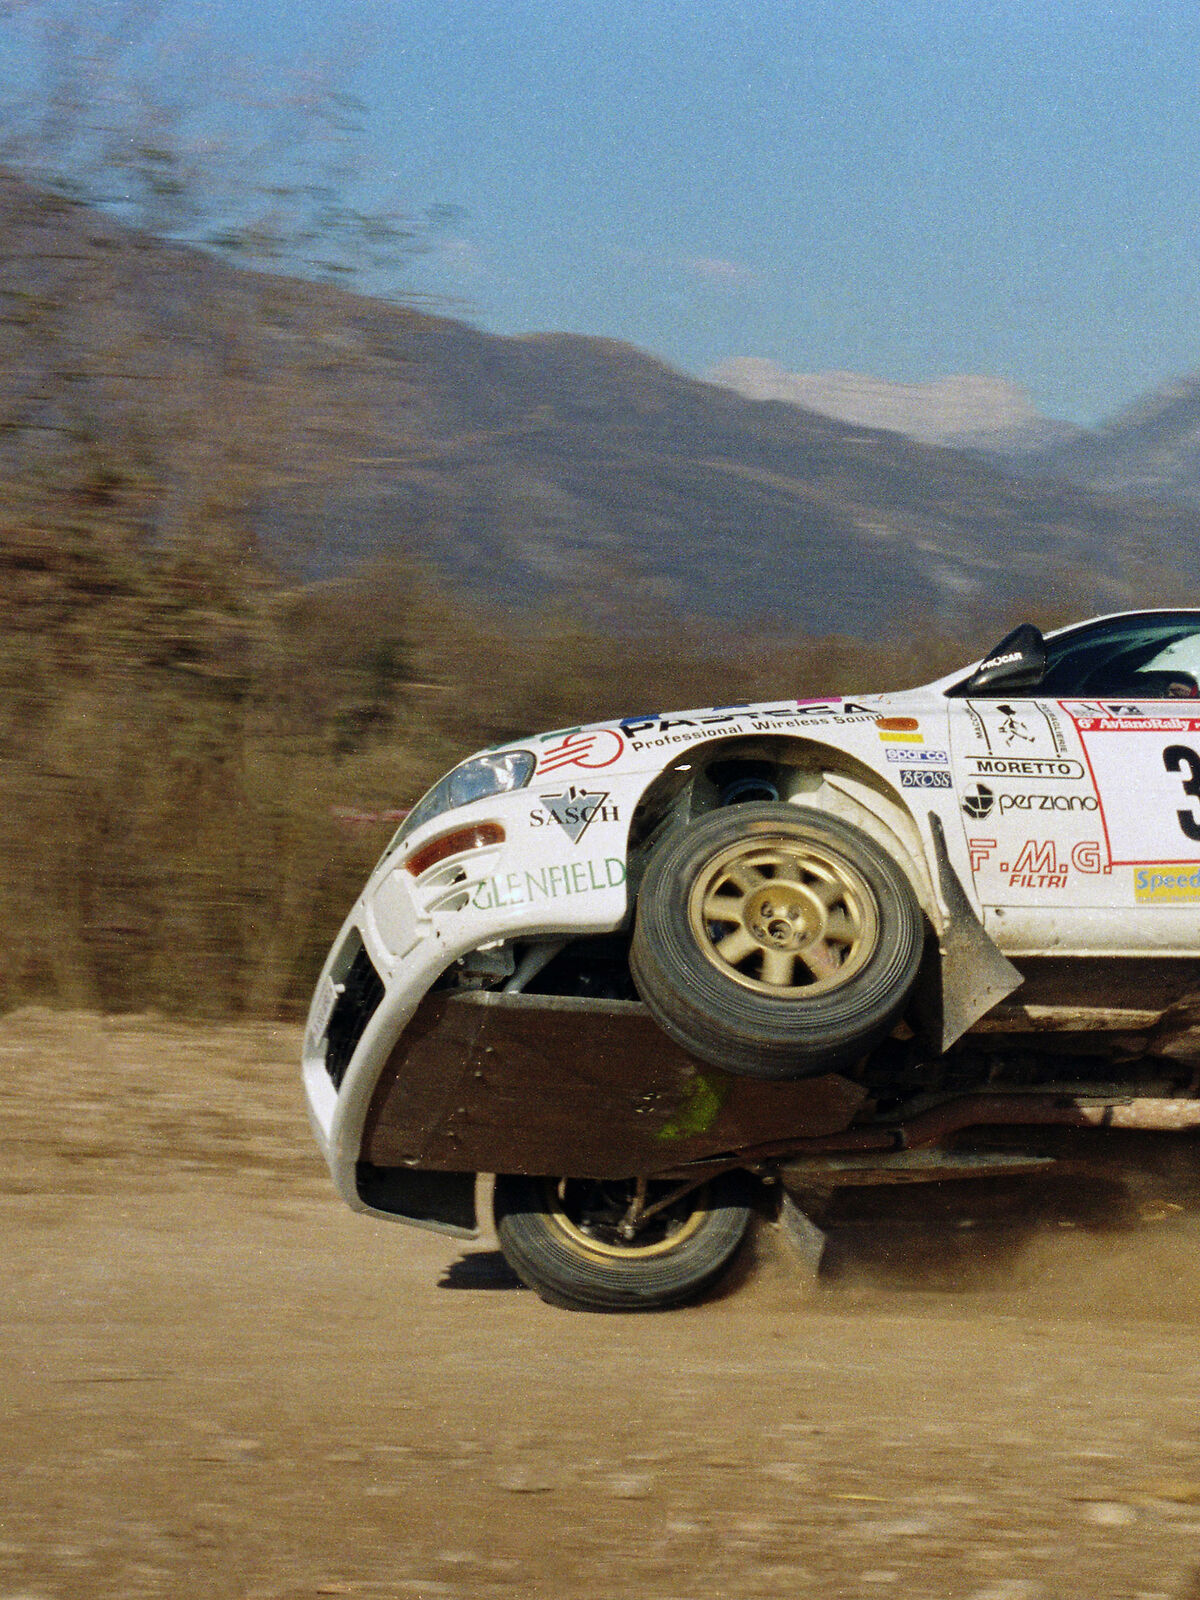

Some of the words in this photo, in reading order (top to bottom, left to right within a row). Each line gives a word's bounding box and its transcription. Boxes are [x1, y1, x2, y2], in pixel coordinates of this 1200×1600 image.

[632, 725, 743, 752] Professional
[752, 716, 832, 731] Wireless
[886, 749, 948, 764] sparco
[977, 760, 1071, 775] MORETTO
[999, 794, 1099, 815] perziano
[529, 804, 621, 827] SASCH
[472, 858, 627, 911] GLENFIELD
[1009, 875, 1068, 888] FILTRI
